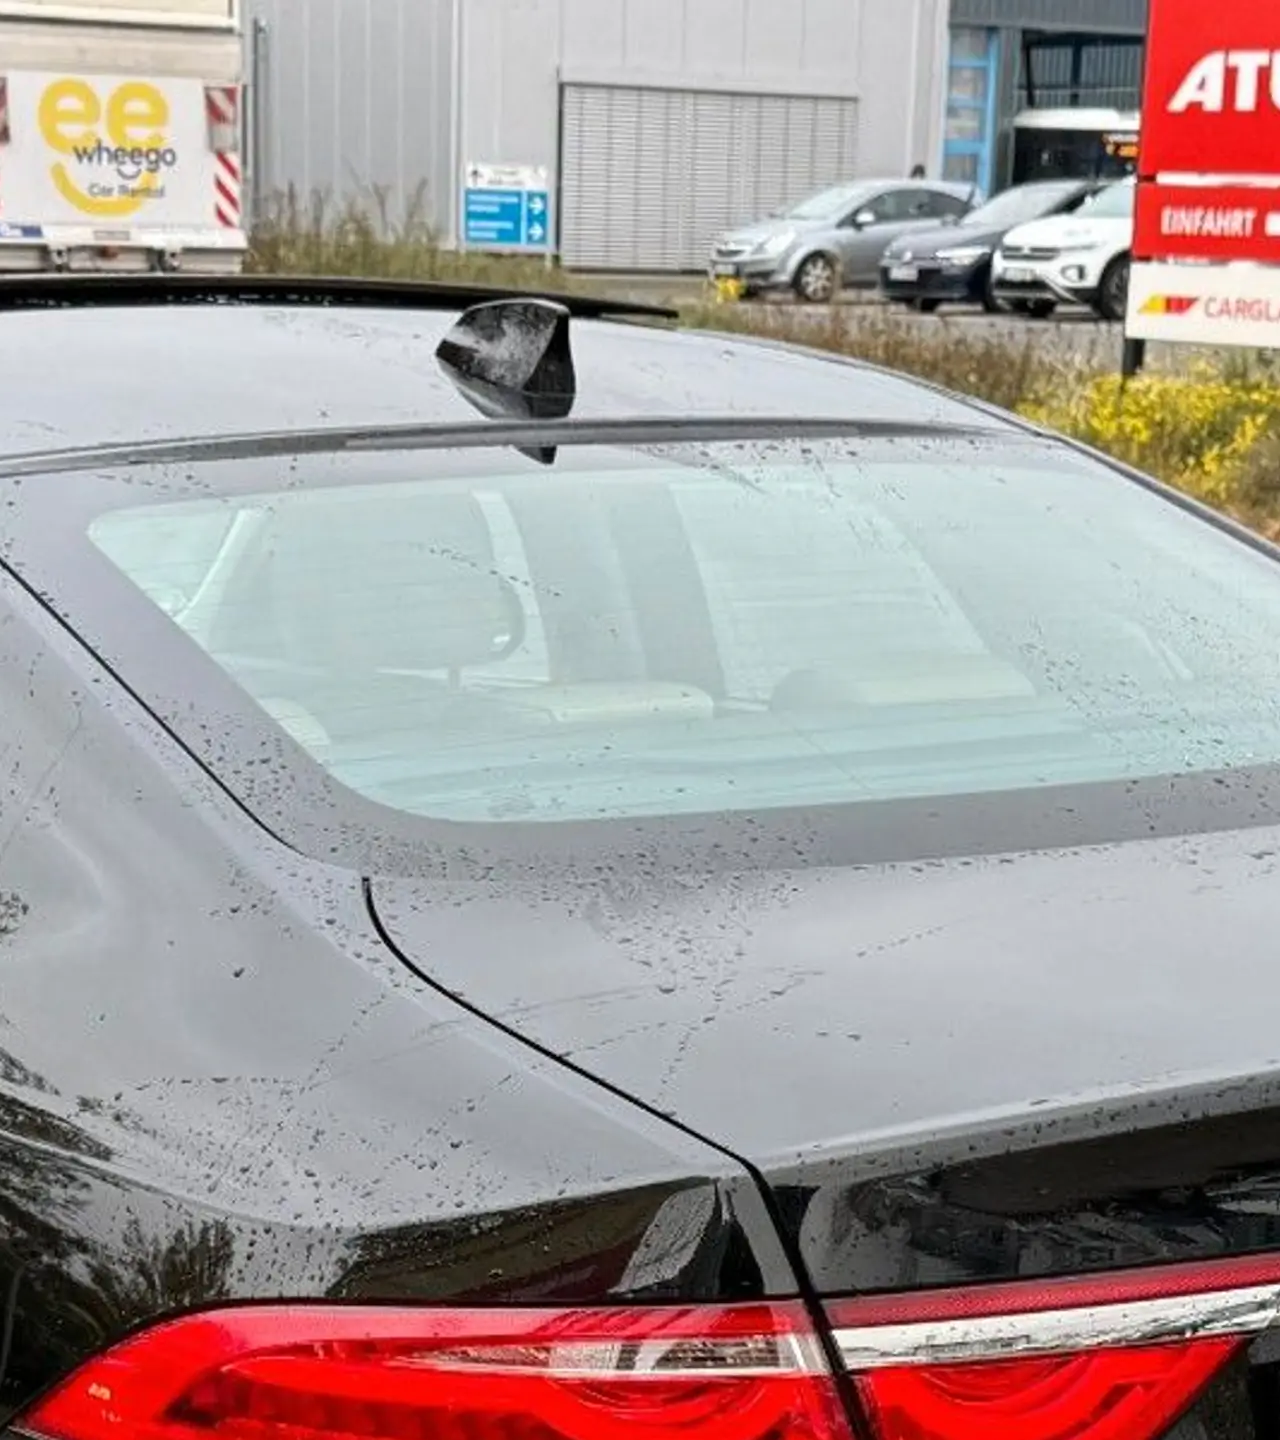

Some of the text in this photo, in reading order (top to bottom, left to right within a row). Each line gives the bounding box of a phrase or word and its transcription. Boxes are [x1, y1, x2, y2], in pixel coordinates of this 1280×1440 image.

[72, 139, 177, 173] wheego
[87, 183, 115, 198] Car
[1160, 206, 1258, 237] EINFAHRT
